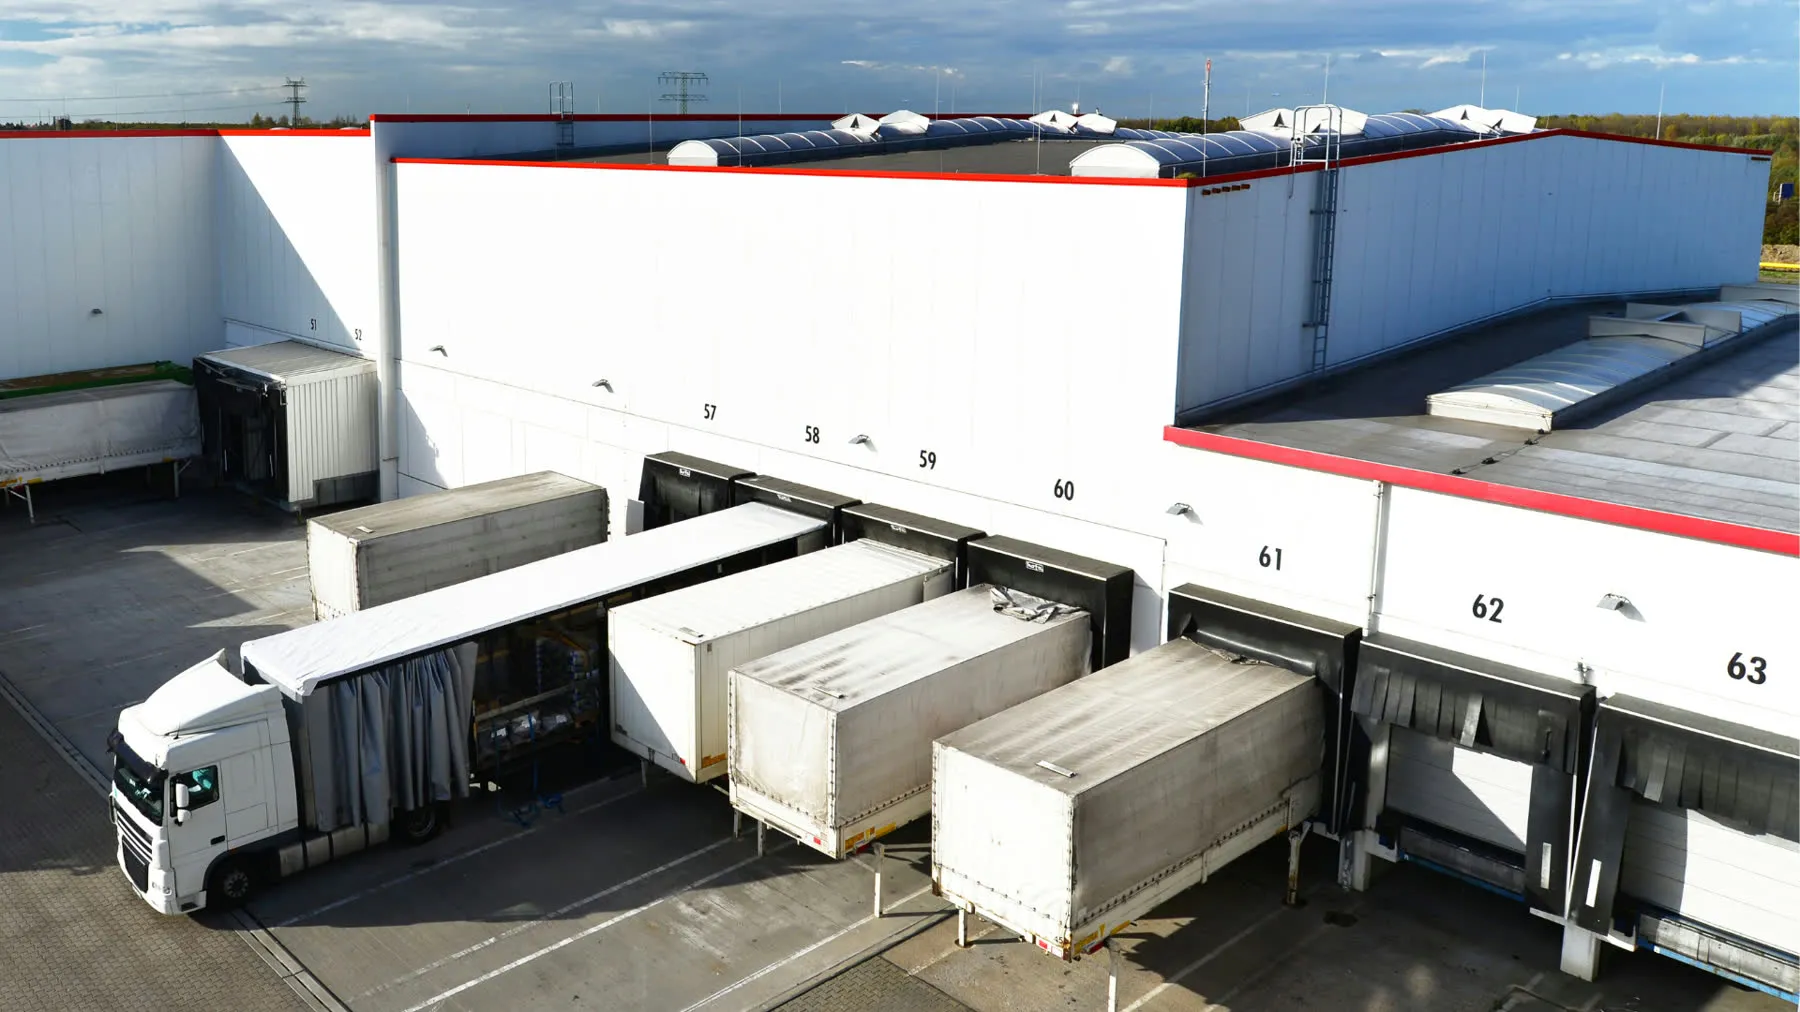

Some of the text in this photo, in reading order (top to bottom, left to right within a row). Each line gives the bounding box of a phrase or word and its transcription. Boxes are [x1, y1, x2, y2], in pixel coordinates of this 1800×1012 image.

[310, 318, 317, 331] 51
[354, 328, 362, 341] 52
[703, 403, 717, 421] 57
[805, 425, 820, 445] 58
[919, 449, 937, 470] 59
[1053, 478, 1075, 501] 60
[1258, 545, 1282, 571] 61
[1472, 593, 1504, 624] 62
[1727, 651, 1767, 685] 63
